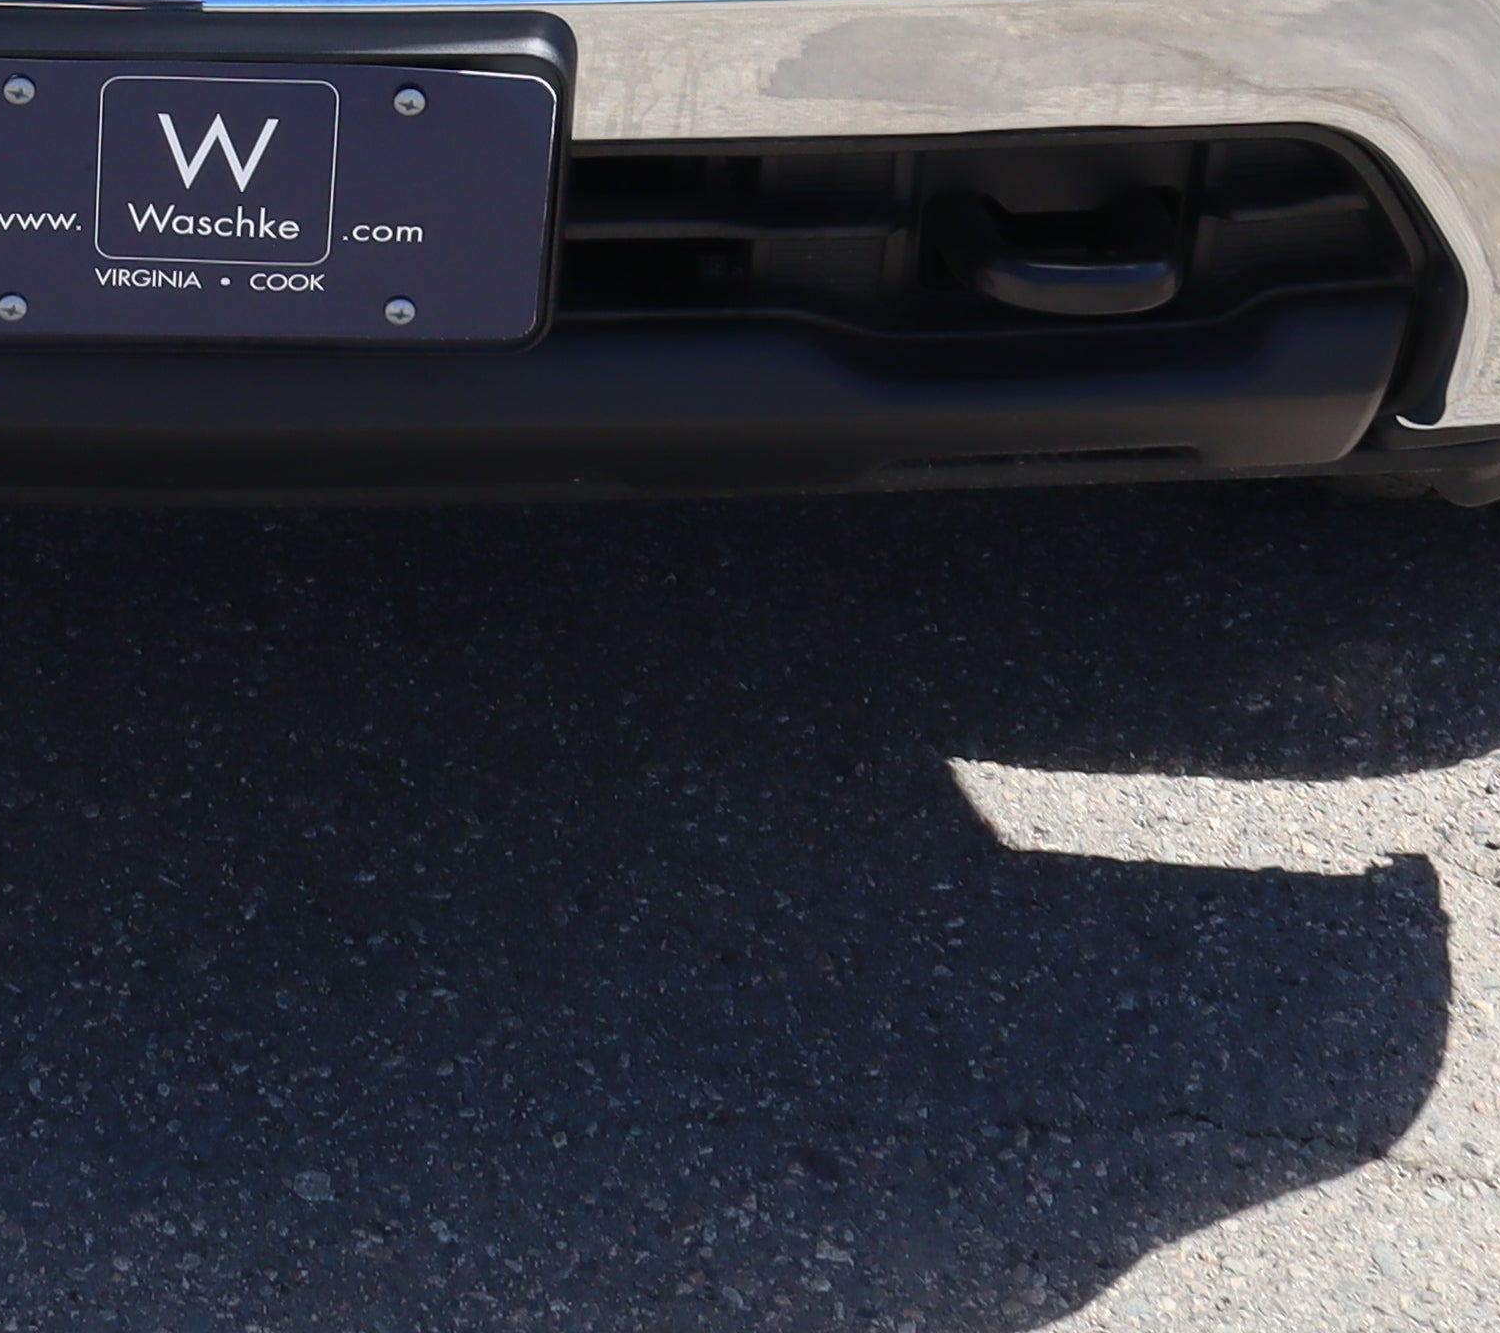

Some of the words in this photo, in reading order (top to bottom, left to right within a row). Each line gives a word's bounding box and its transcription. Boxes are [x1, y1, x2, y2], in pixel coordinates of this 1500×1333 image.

[157, 112, 280, 193] W
[127, 202, 300, 240] Waschke
[342, 224, 424, 243] .com
[94, 268, 202, 290] VIRGINIA
[249, 272, 326, 292] COOK
